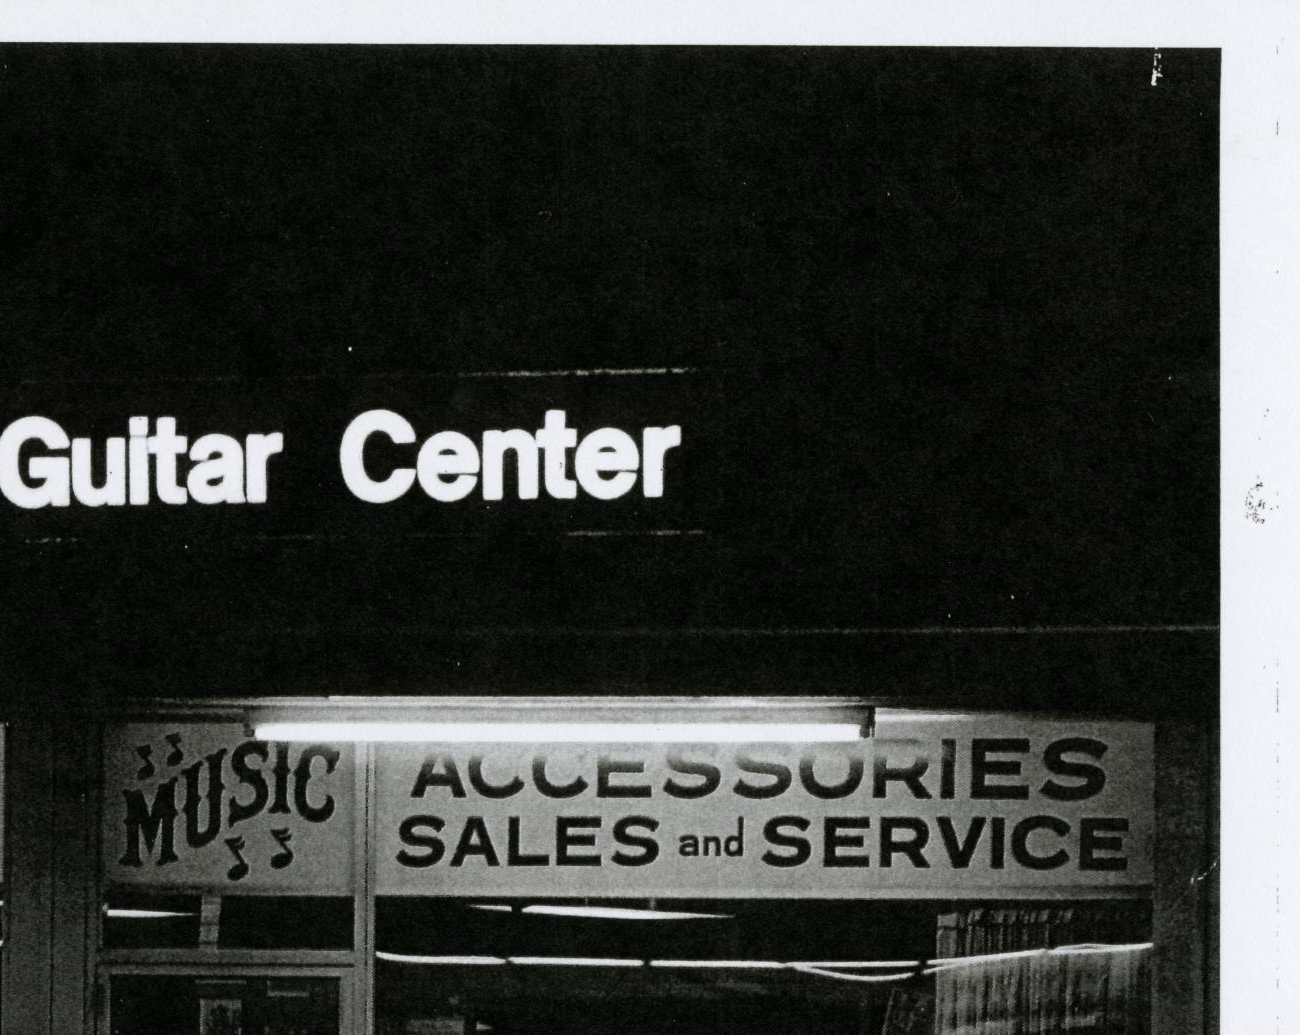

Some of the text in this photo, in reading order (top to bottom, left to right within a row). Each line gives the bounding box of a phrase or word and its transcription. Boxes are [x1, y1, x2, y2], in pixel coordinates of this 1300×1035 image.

[340, 409, 682, 503] Center
[118, 740, 341, 868] MUSIC
[410, 738, 1109, 800] ACCESSORIES
[395, 814, 1130, 871] SALES and SERVICE
